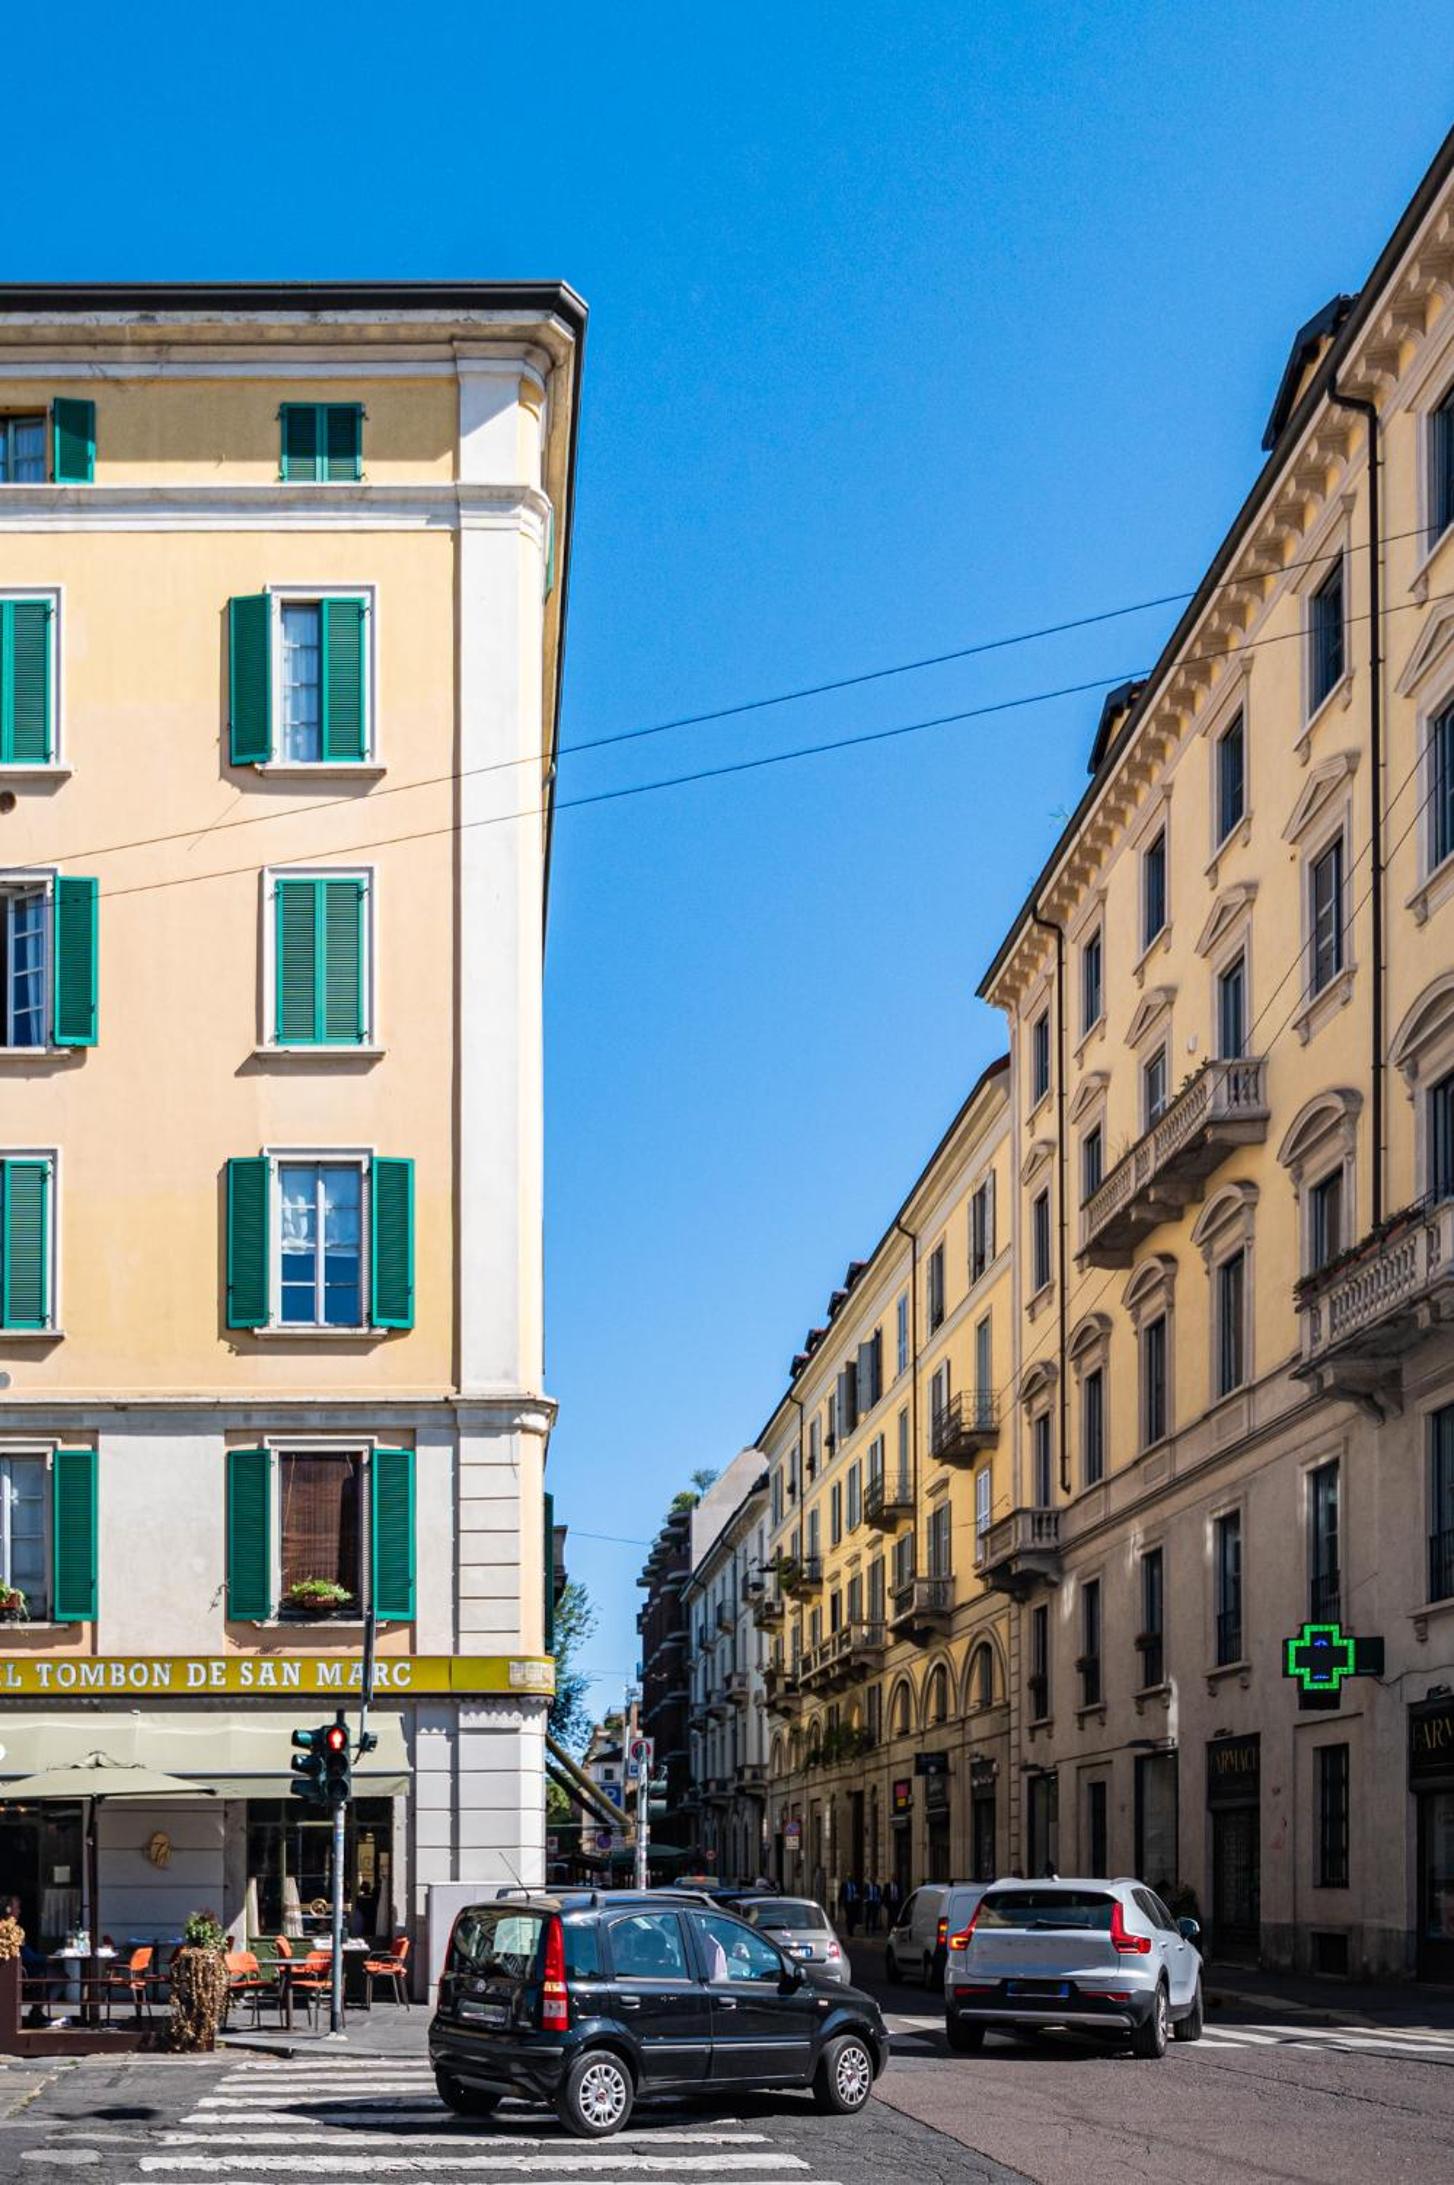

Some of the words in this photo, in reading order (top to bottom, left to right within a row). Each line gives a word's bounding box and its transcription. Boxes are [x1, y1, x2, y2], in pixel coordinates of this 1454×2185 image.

[0, 1663, 22, 1687] L
[36, 1663, 172, 1688] TOMBON
[187, 1662, 226, 1687] DE
[240, 1662, 300, 1686] SAN
[316, 1662, 411, 1686] MARC
